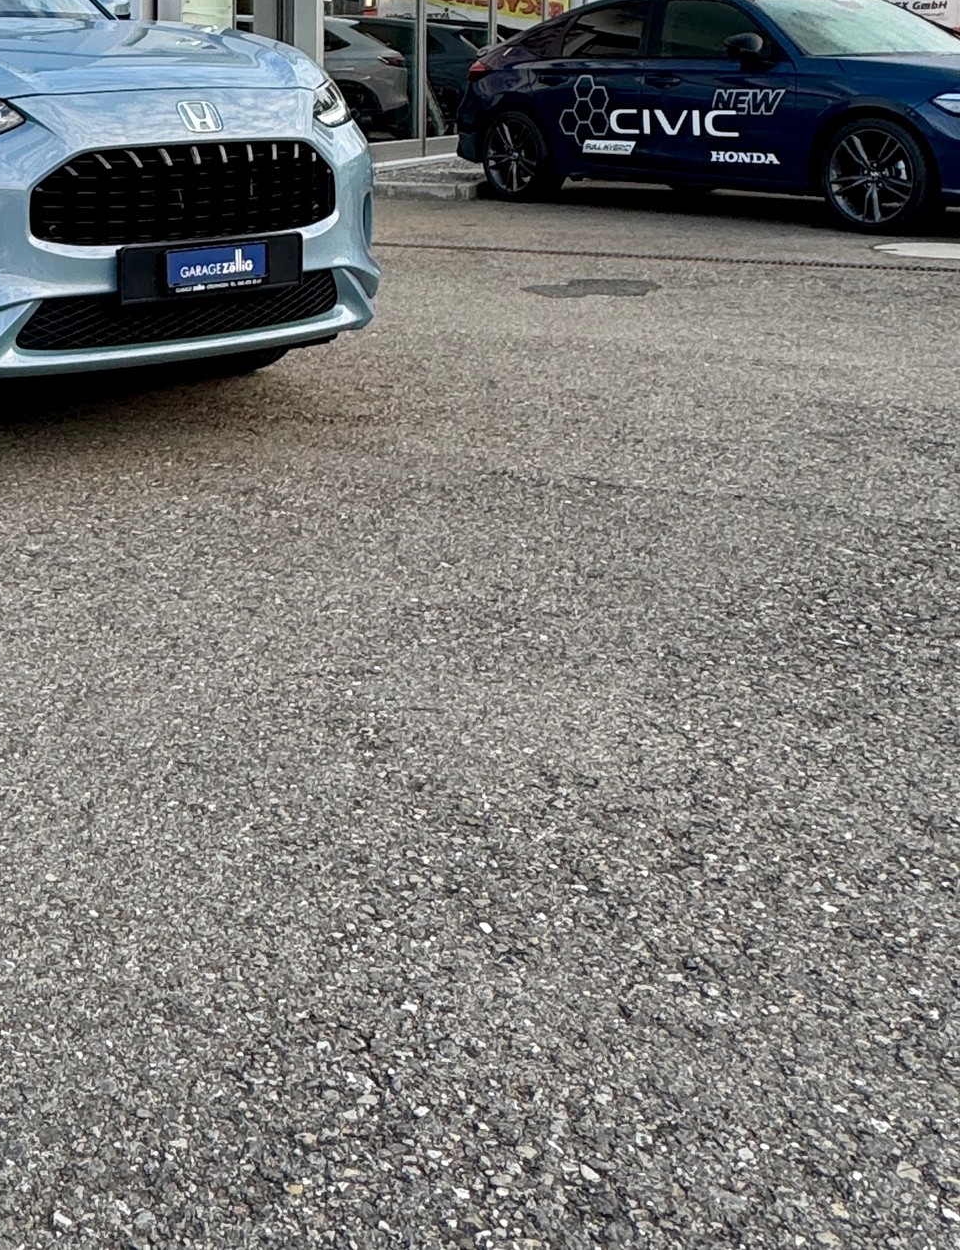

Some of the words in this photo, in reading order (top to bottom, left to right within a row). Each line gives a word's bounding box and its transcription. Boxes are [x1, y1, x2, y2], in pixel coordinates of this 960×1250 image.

[912, 0, 948, 11] GmbH
[712, 89, 785, 115] NEW
[609, 109, 740, 137] CIVIC
[710, 150, 780, 164] HONDA
